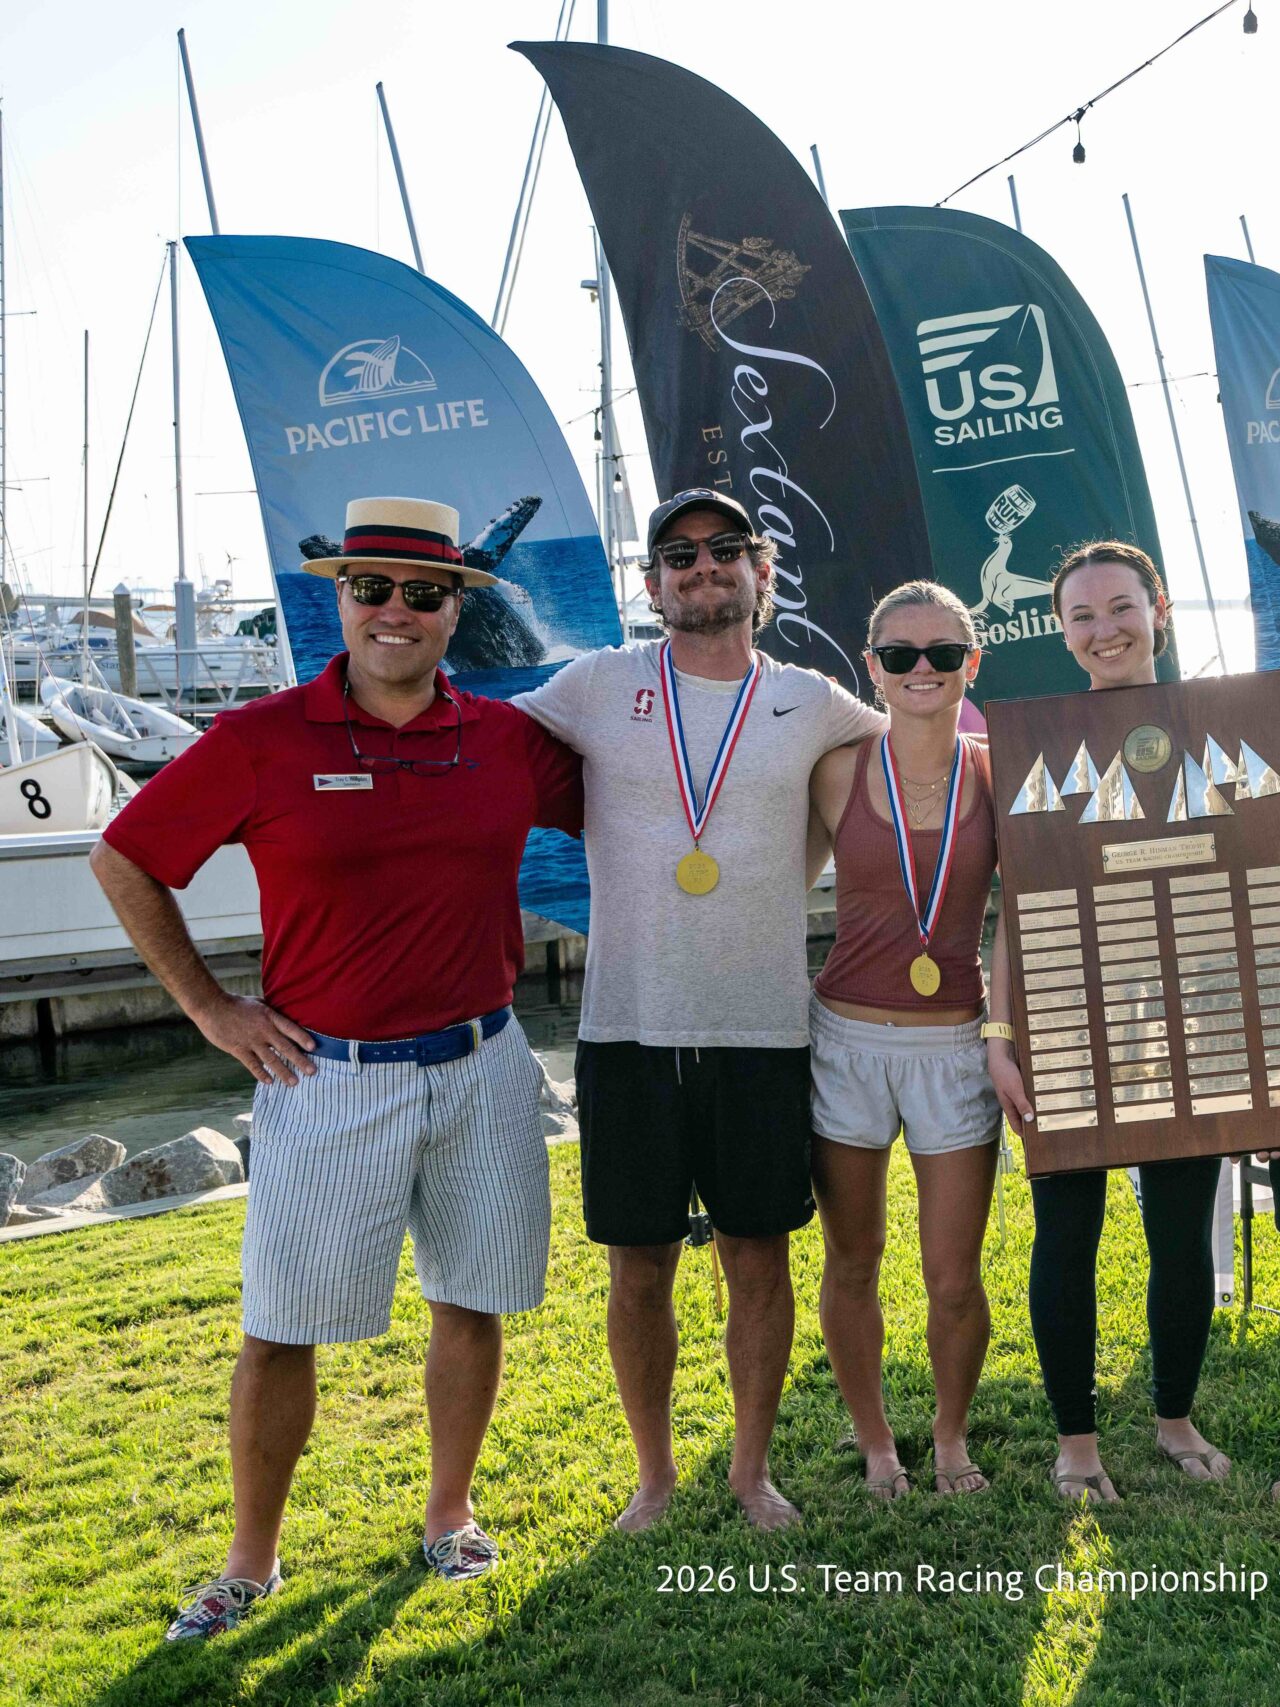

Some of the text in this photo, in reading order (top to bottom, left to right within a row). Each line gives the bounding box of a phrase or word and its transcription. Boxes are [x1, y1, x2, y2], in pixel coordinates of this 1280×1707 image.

[924, 363, 1027, 431] US
[284, 399, 489, 455] PACIFIC LIFE
[934, 406, 1064, 446] SAILING
[702, 424, 734, 489] EST
[710, 277, 860, 697] Sextant
[994, 494, 1026, 527] RUM
[20, 779, 52, 820] 8
